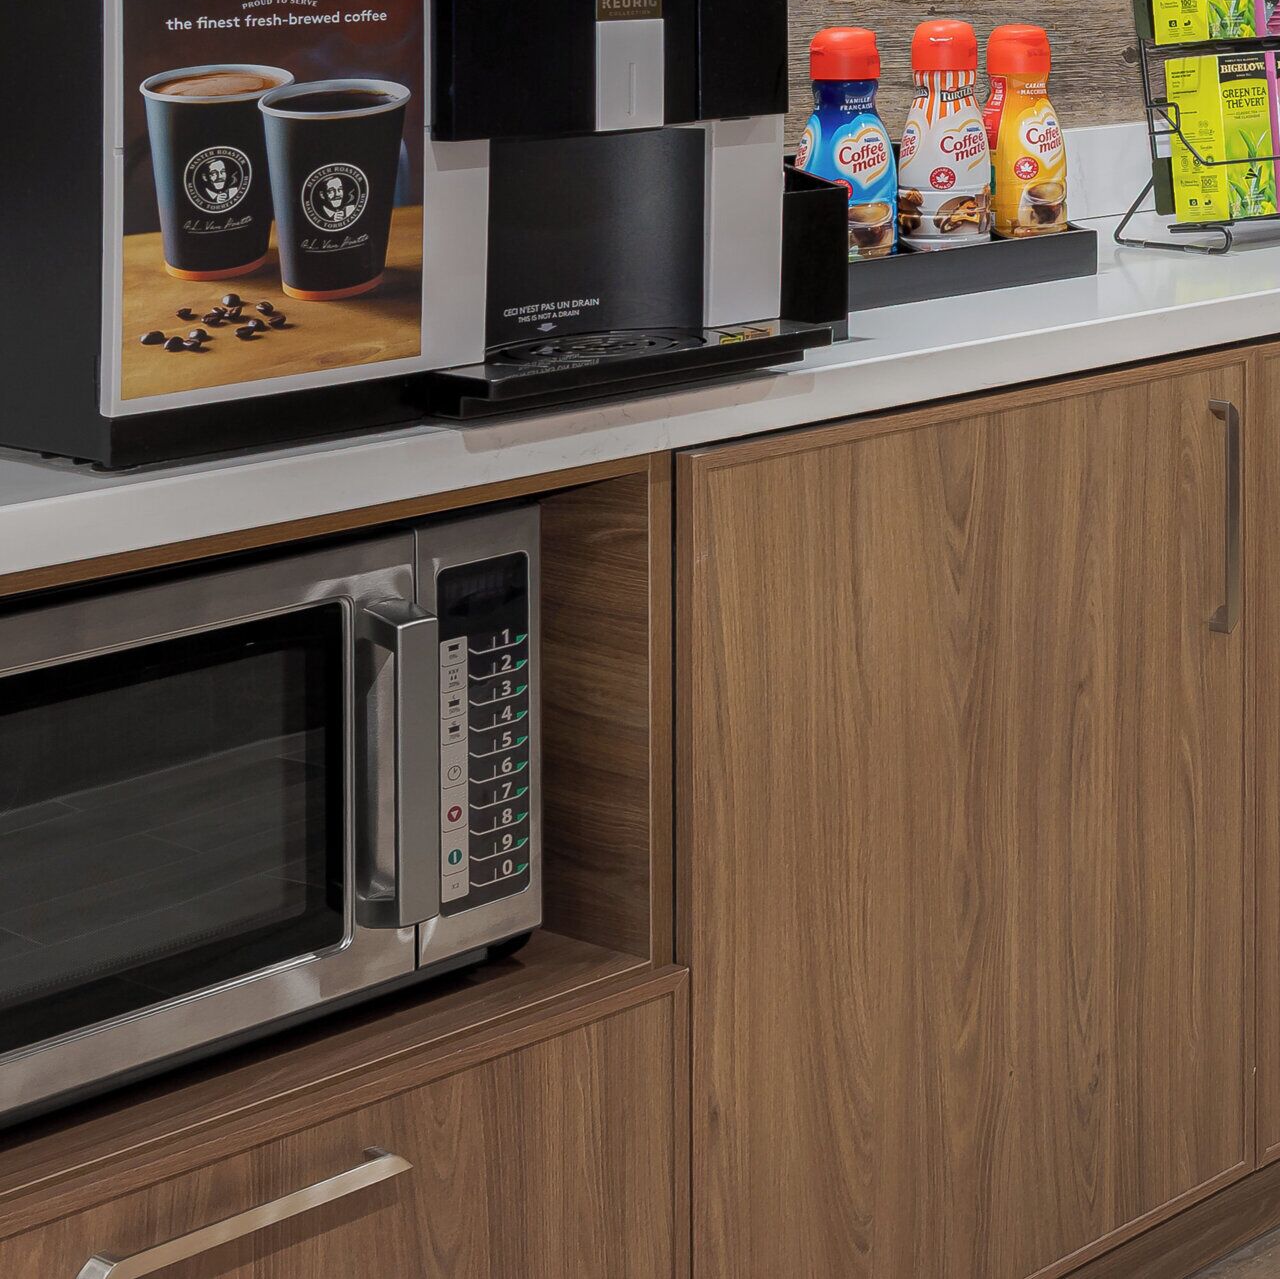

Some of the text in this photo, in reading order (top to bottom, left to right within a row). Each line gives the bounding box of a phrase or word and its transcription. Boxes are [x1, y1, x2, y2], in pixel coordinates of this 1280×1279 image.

[166, 10, 388, 31] the finest fresh-brewed coffee
[1223, 87, 1267, 98] GREEN TEA
[1244, 97, 1264, 107] VERT
[940, 132, 983, 153] Coffee
[1026, 127, 1059, 144] Coffee
[839, 142, 883, 165] Coffee
[955, 140, 985, 161] mate
[852, 151, 886, 173] mate
[334, 167, 363, 182] ROASTER
[503, 308, 518, 317] CECI
[541, 302, 555, 311] PAS
[557, 301, 570, 309] UN
[572, 298, 599, 307] DRAIN
[558, 309, 580, 317] DRAIN
[502, 628, 509, 644] 1
[501, 654, 512, 671] 2
[502, 680, 511, 696] 3
[501, 705, 512, 720] 4
[502, 731, 511, 747] 5
[501, 757, 512, 772] 6
[502, 782, 512, 799] 7
[502, 808, 512, 824] 8
[502, 834, 512, 850] 9
[502, 859, 512, 875] 0
